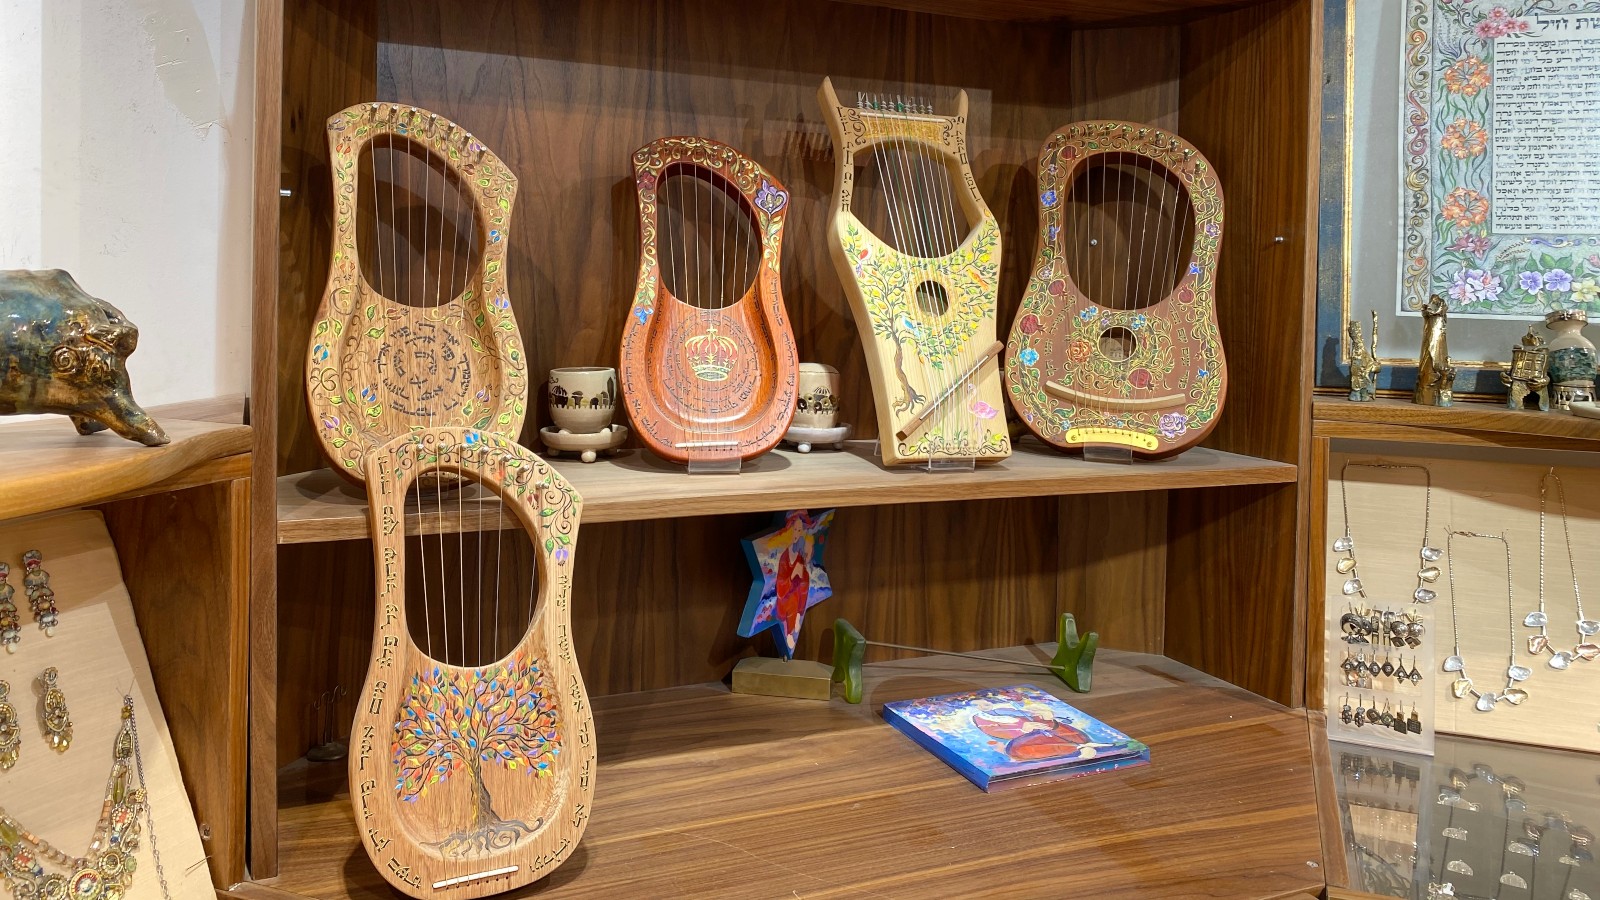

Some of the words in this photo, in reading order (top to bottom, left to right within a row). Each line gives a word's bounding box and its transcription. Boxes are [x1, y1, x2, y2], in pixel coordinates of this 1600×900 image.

[1535, 12, 1568, 32] חיל
[952, 130, 968, 165] לעולם
[964, 172, 981, 202] חסדו
[380, 546, 398, 598] שתול
[380, 603, 399, 630] על
[368, 680, 388, 714] מים
[570, 674, 584, 713] אשר
[358, 725, 375, 771] אשר
[578, 716, 592, 748] וכל
[571, 802, 588, 828] לא
[368, 828, 392, 852] יתן
